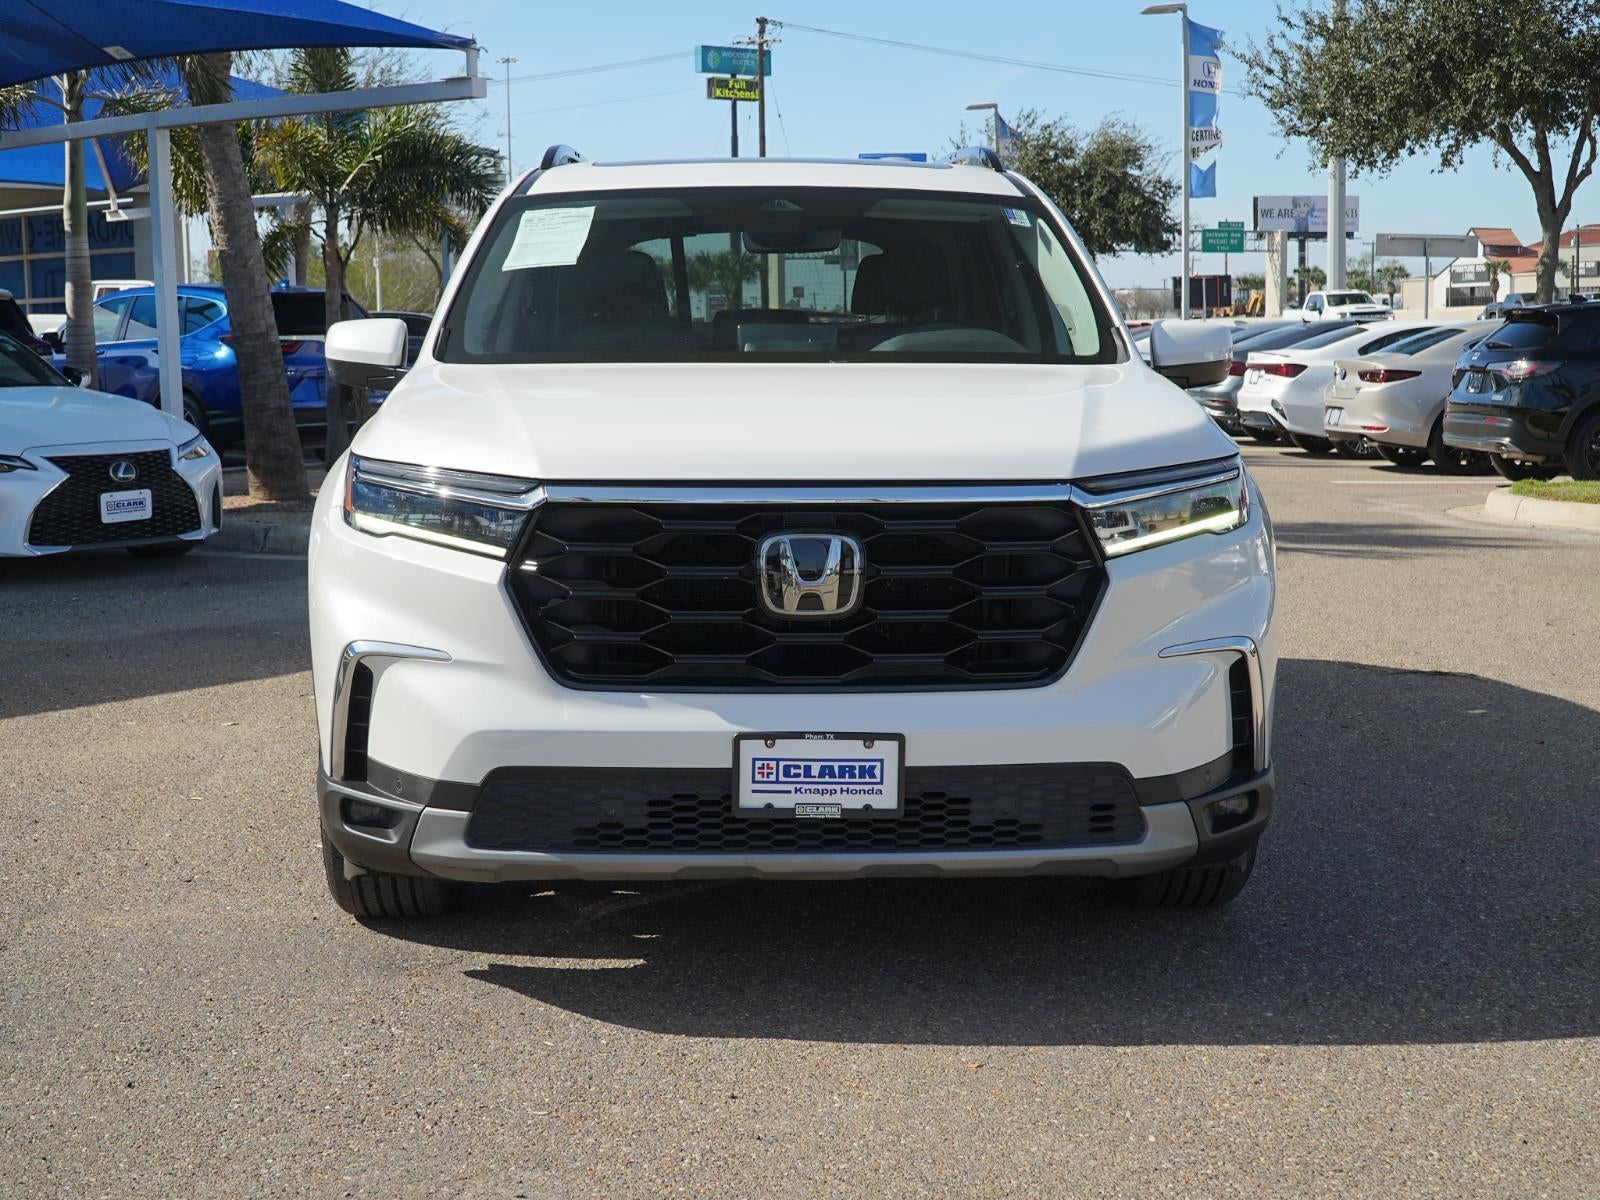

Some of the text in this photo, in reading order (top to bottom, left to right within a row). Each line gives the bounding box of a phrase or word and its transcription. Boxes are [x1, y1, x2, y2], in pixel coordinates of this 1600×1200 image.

[728, 80, 746, 89] Full
[716, 88, 759, 99] Kitchens!
[1261, 207, 1296, 219] WE ARE
[116, 500, 145, 508] CLARK
[782, 764, 878, 779] CLARK
[794, 786, 883, 797] Knapp Honda
[805, 805, 840, 814] CLARK
